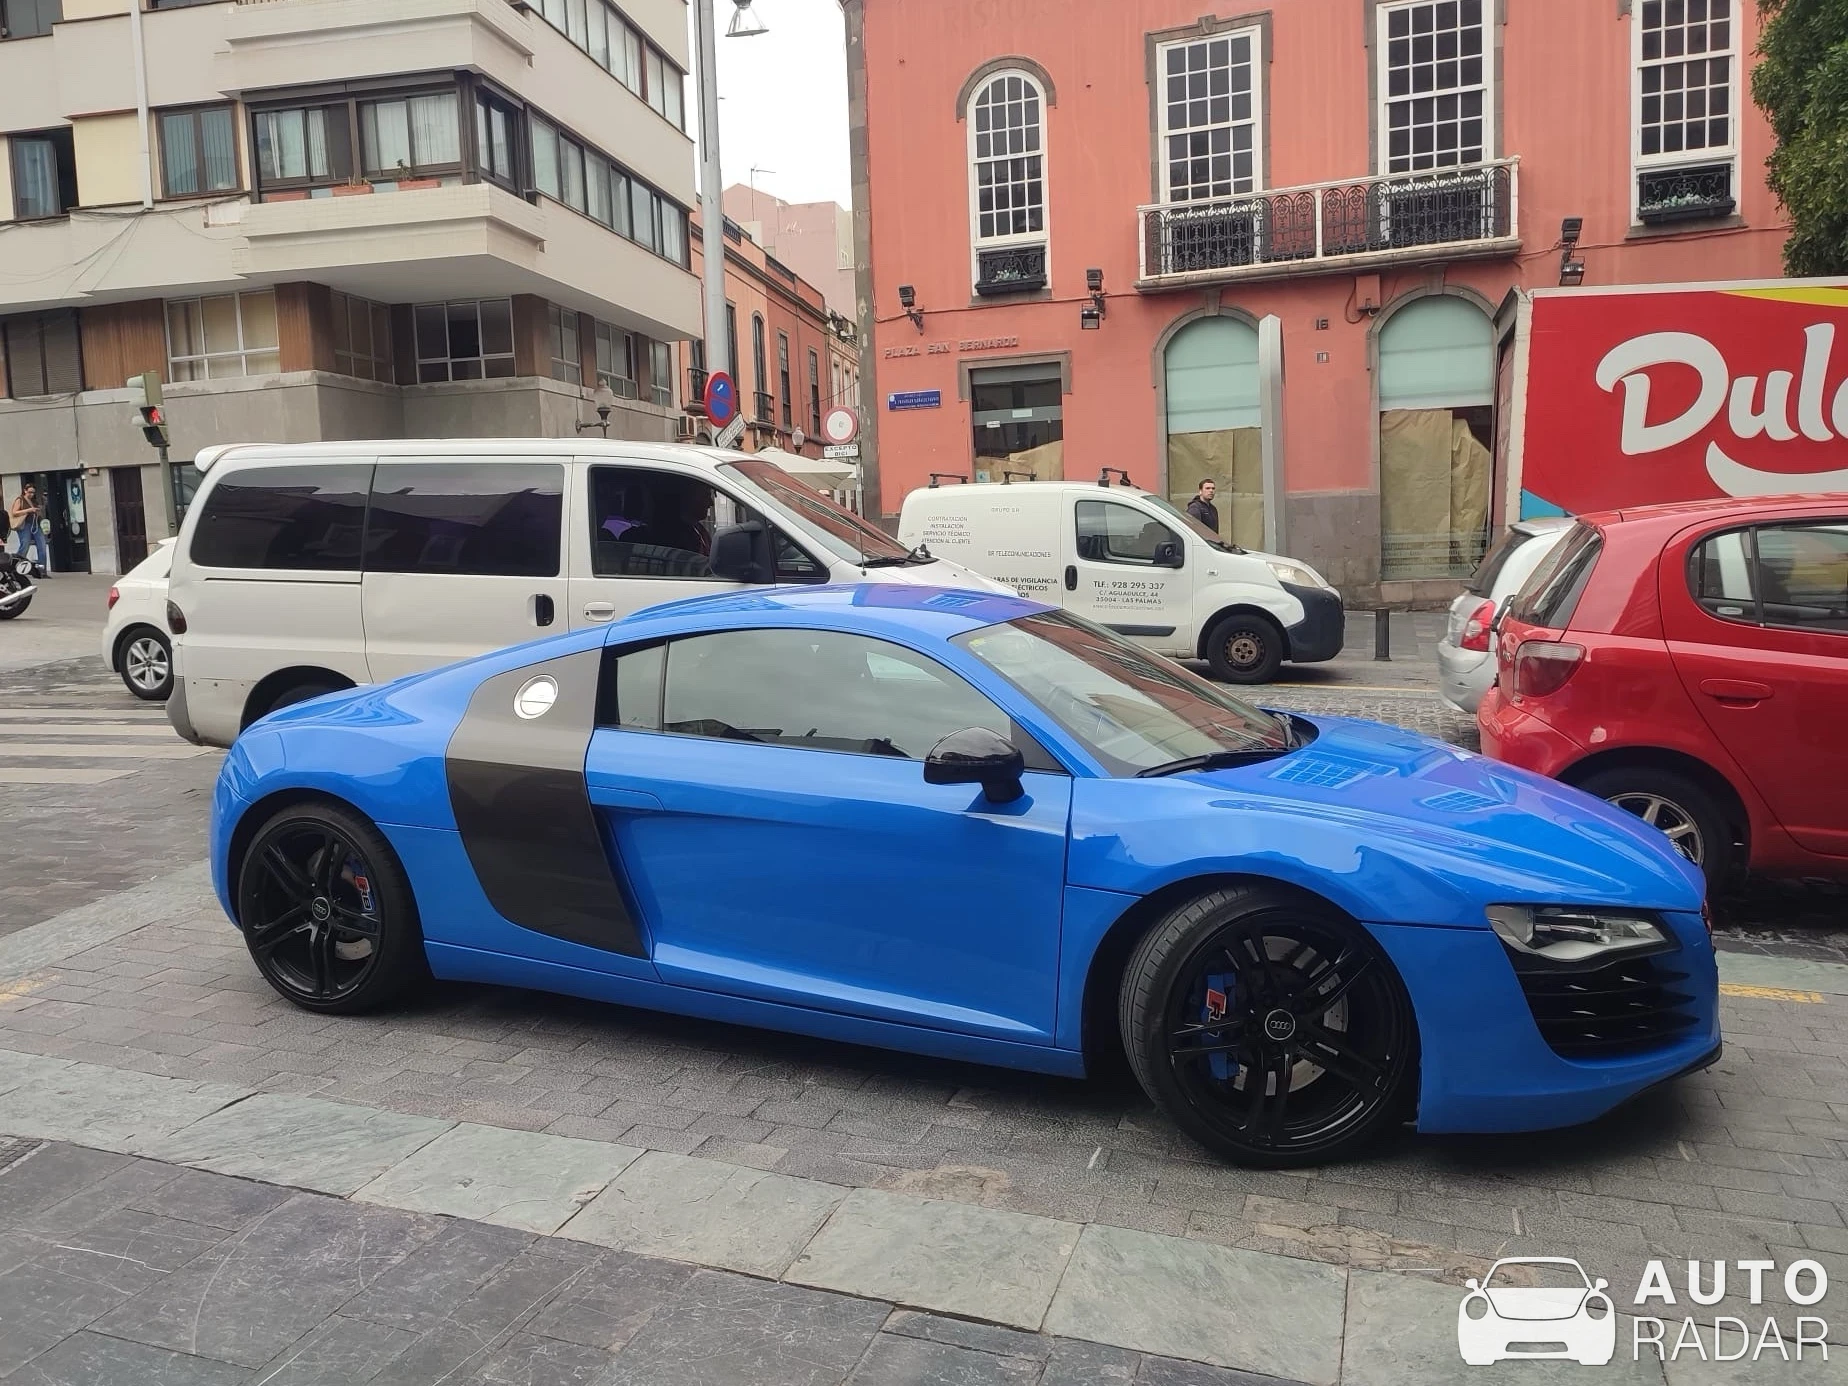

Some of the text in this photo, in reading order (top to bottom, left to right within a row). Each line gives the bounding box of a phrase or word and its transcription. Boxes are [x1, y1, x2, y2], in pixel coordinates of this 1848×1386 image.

[884, 337, 1019, 359] PLAZA SAN BERNARDO
[824, 444, 858, 452] EXCEPTO
[1111, 581, 1128, 589] 928
[1130, 581, 1146, 589] 295
[1148, 582, 1165, 590] 337
